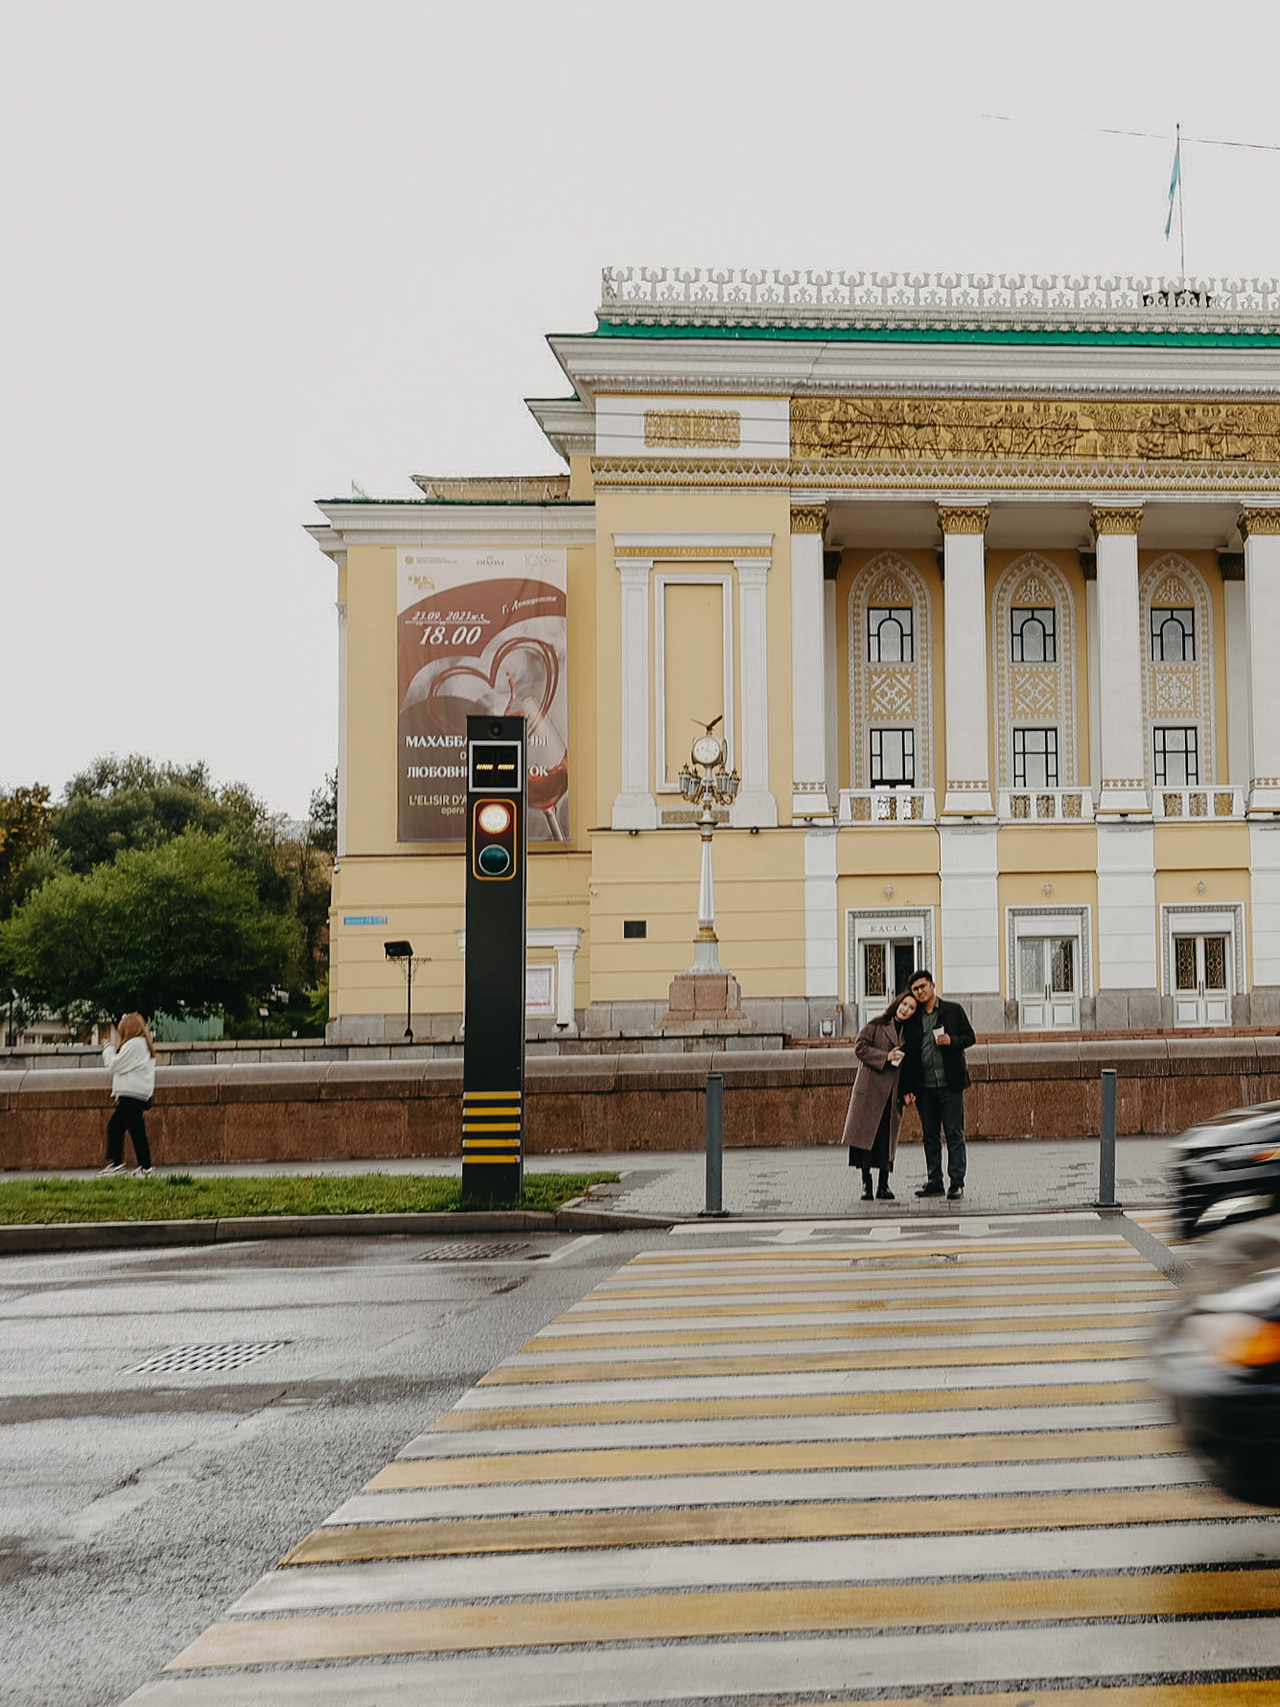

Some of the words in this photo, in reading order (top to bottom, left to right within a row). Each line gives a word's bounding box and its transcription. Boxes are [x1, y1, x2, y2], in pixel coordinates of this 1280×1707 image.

[419, 625, 482, 646] 18.00
[407, 765, 468, 779] ЛЮБОВН
[441, 806, 465, 817] opera
[870, 924, 909, 934] КАССА
